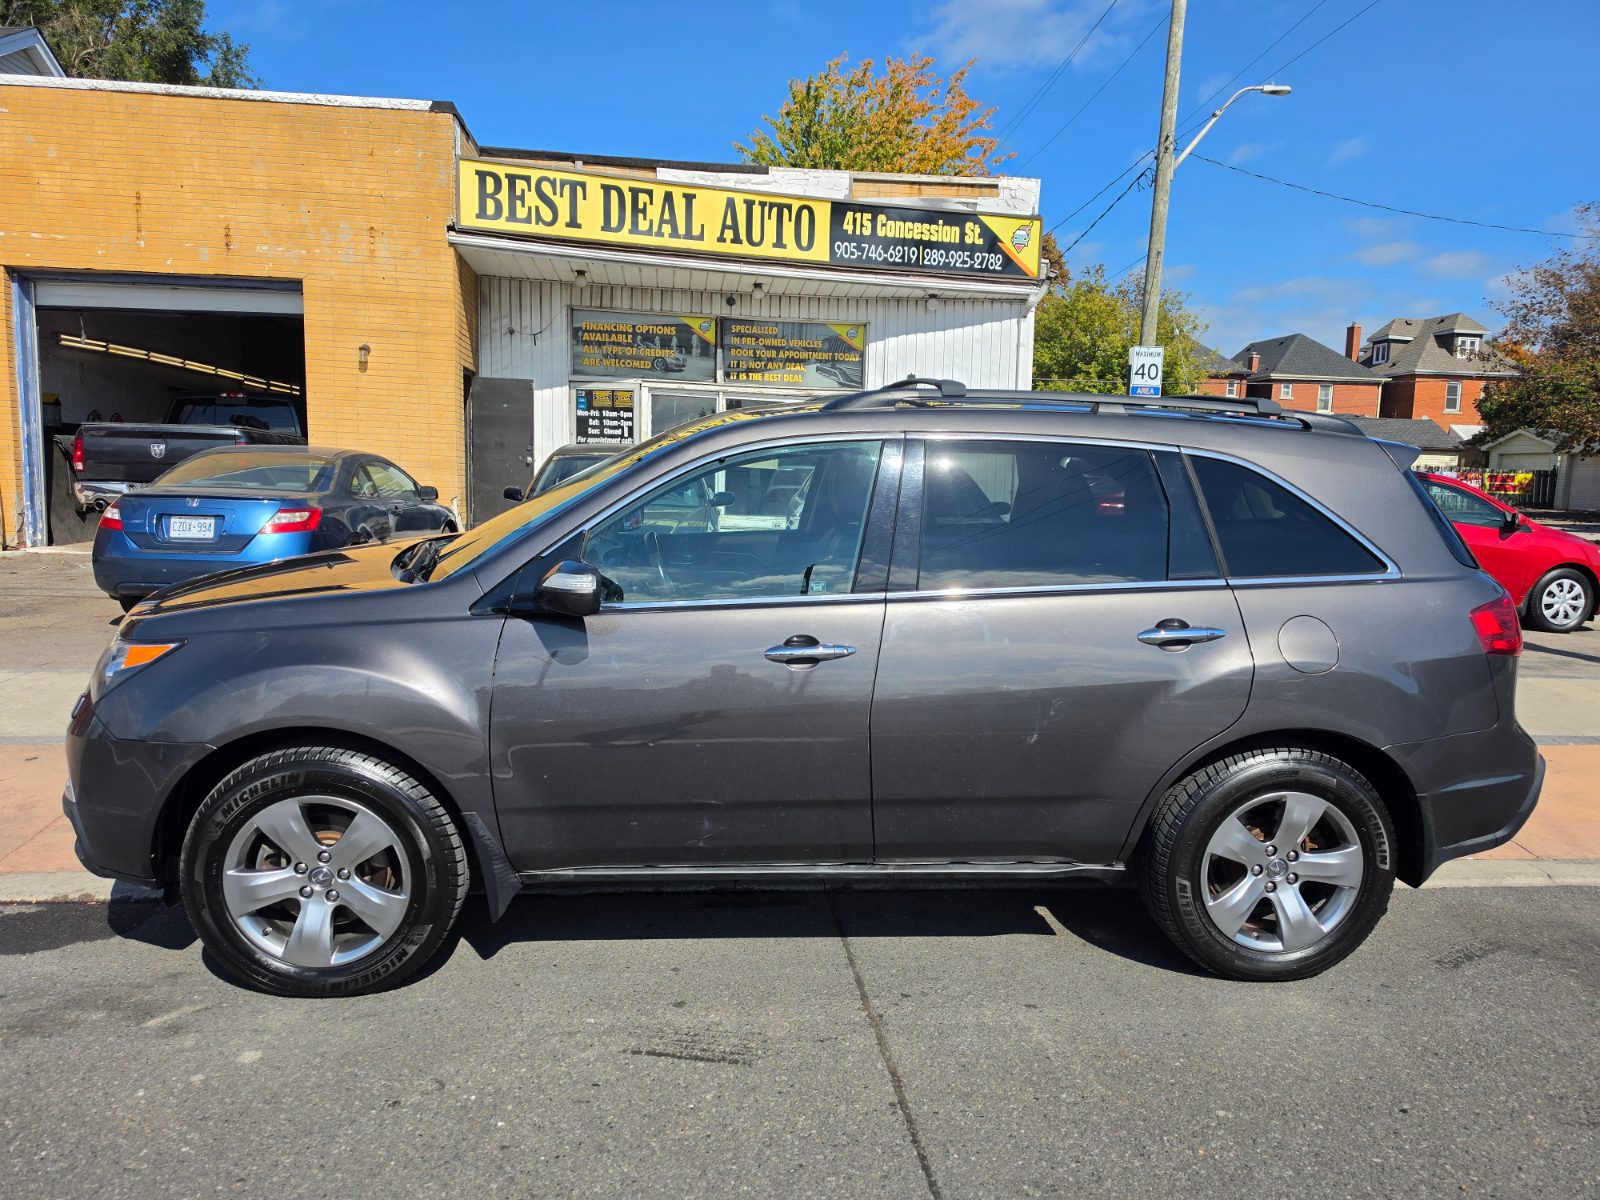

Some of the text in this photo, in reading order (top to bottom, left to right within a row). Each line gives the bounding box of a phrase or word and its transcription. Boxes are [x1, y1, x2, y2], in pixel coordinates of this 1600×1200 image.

[475, 170, 815, 252] BEST DEAL AUTO
[843, 211, 984, 245] 415 Concession St.
[582, 322, 676, 335] FINANCING OPTIONS
[732, 325, 778, 335] SPECIALIZED
[583, 332, 632, 342] AVAILABLE
[742, 338, 786, 347] PRE-OWNED
[789, 339, 822, 348] VEHICLES
[583, 345, 675, 358] ALL TYPE OF CREDITS
[730, 348, 754, 357] BOOK
[779, 350, 832, 360] APPOINTMENT
[602, 359, 652, 369] WELCOMED
[767, 362, 783, 370] ANY
[786, 363, 807, 372] DEAL,
[1134, 364, 1158, 380] 40
[764, 374, 782, 382] BEST
[784, 374, 803, 382] DEAL
[602, 410, 632, 418] 10am-6pm
[221, 770, 300, 818] MICHELIN
